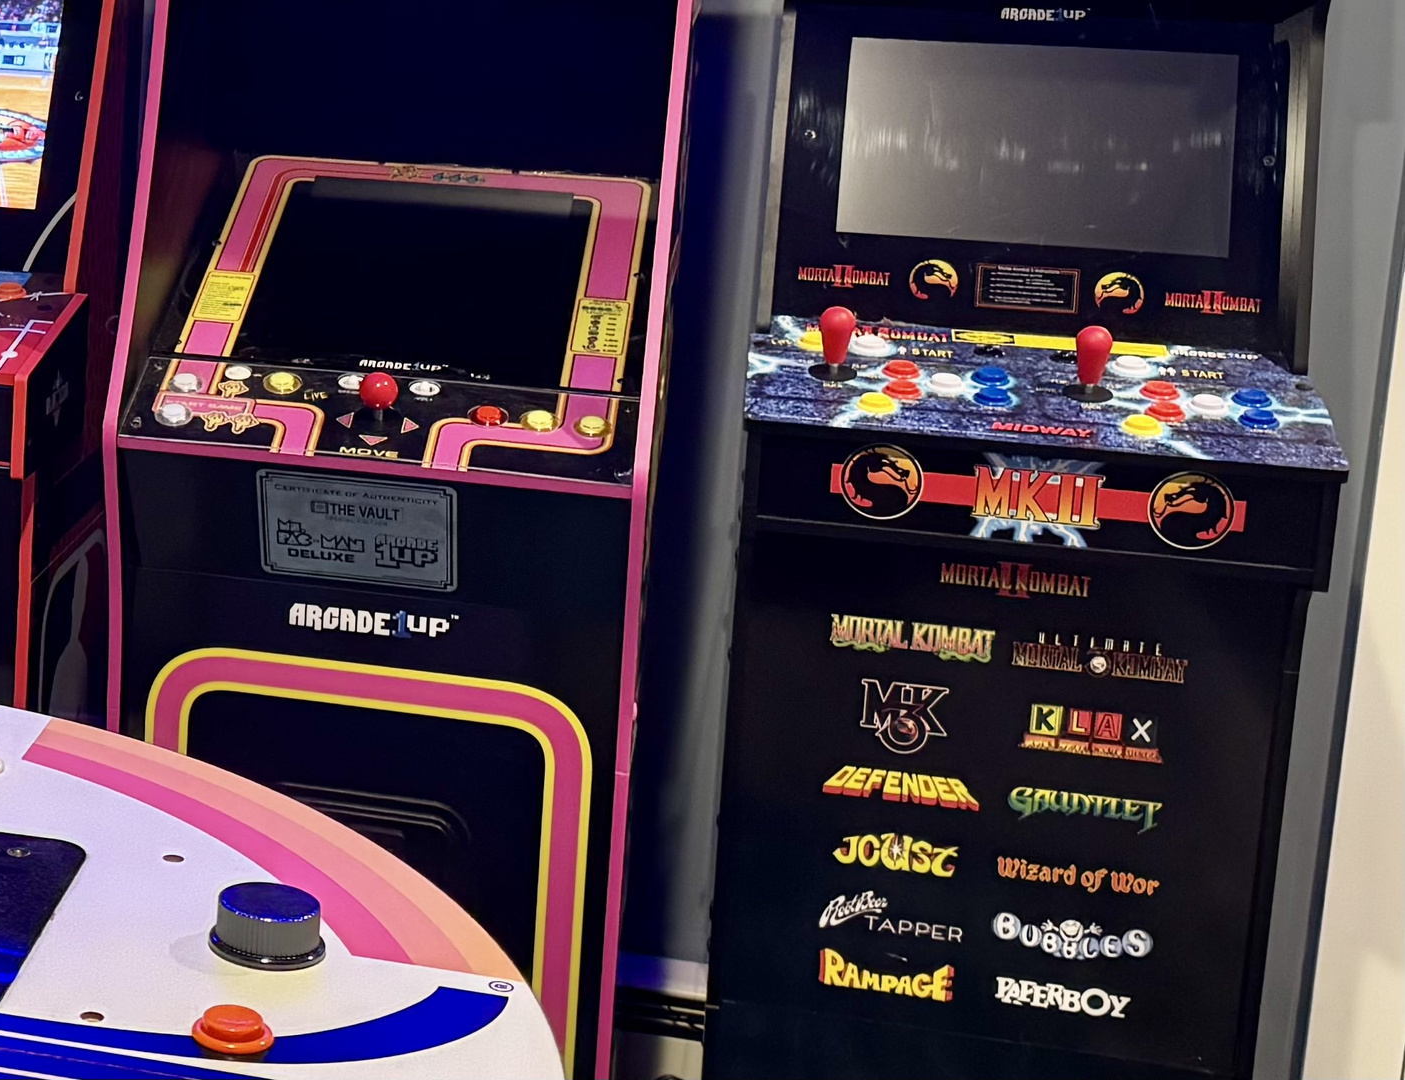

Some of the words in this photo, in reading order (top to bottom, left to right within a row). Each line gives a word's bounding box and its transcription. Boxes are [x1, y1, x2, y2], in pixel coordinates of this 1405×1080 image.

[911, 348, 954, 359] START
[1180, 369, 1225, 380] START
[991, 421, 1091, 438] MIDWAY
[339, 446, 399, 459] MOVE
[329, 503, 356, 517] THE
[359, 505, 401, 521] VAULT
[974, 463, 1106, 529] MKII
[287, 547, 356, 563] DELUXE
[940, 563, 1012, 590] MORTAL
[1016, 569, 1092, 598] KOMBAT
[289, 603, 451, 638] ARCADE1UP
[829, 613, 909, 651] MORTAL
[909, 621, 995, 660] KOMBAT
[1011, 641, 1083, 672] MORTAL
[1111, 651, 1189, 683] KOMBAT
[1038, 631, 1163, 657] ULTIMATE
[1032, 705, 1154, 744] KLAX
[822, 765, 980, 811] DEFENDER
[1007, 785, 1162, 834] GAUNTLET
[832, 832, 959, 877] JOUST
[996, 855, 1077, 885] Wizard
[1080, 867, 1104, 893] of
[1110, 870, 1160, 896] Wor
[863, 914, 963, 943] TAPPER
[992, 911, 1154, 959] BUBBLES
[819, 947, 954, 1002] RAMPAGE
[994, 975, 1131, 1018] PAPERBOY
